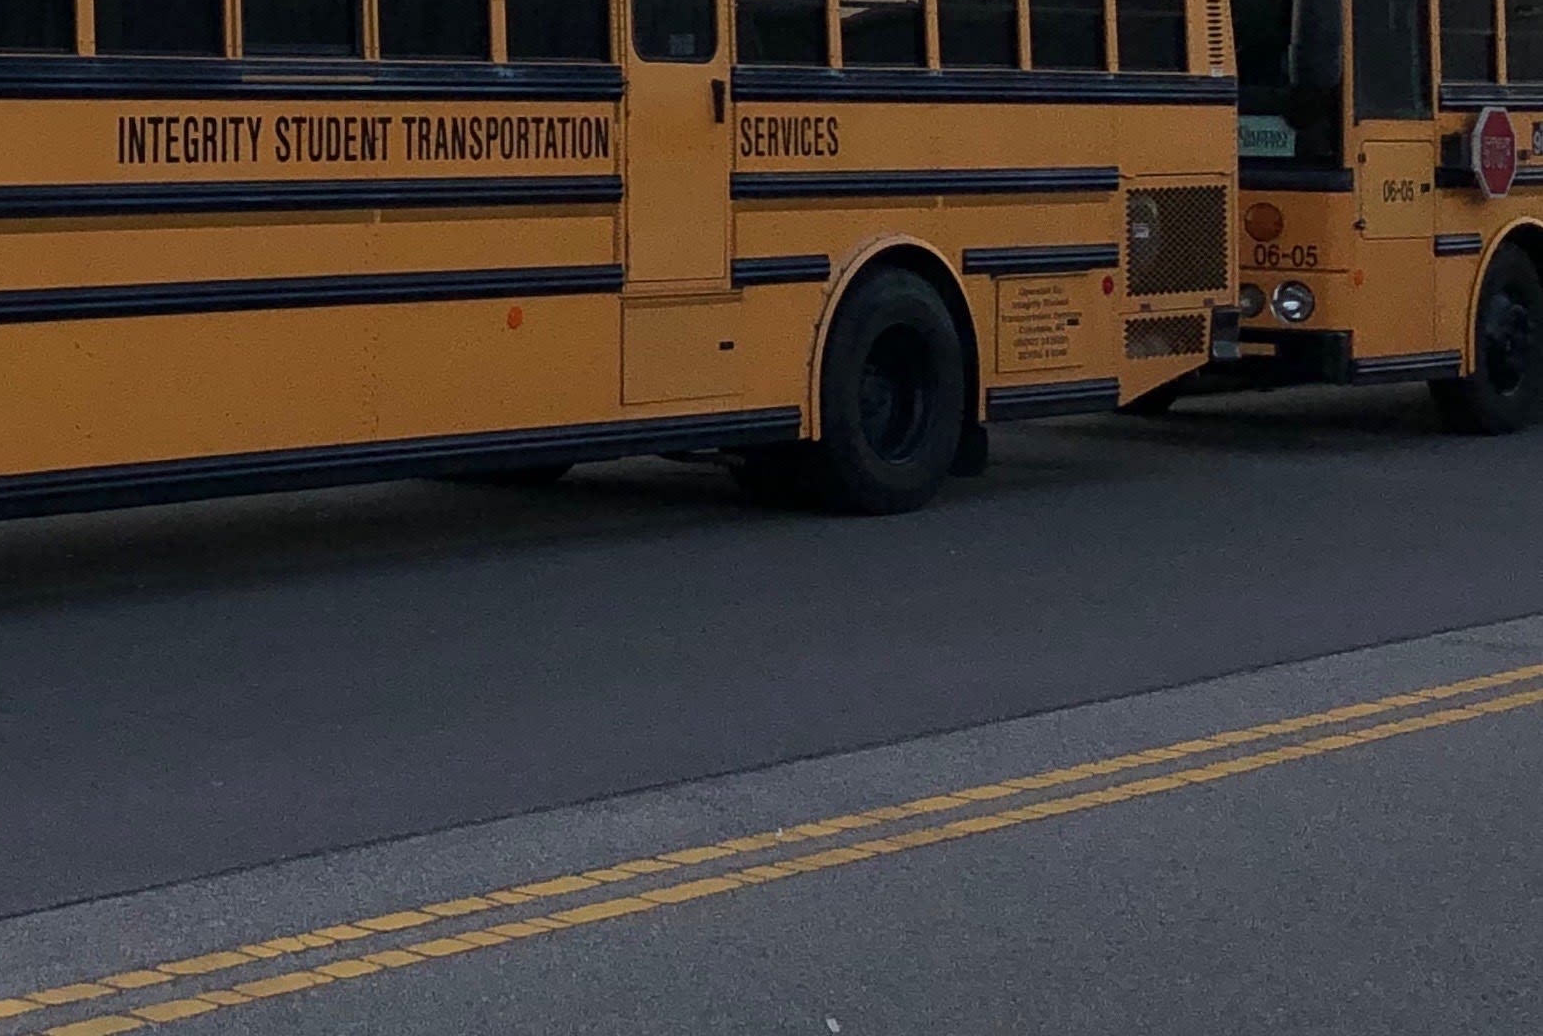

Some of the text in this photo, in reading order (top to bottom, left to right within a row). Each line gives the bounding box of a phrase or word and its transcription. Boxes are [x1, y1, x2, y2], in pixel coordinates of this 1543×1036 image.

[118, 116, 840, 165] INTEGRITY STUDENT TRANSPORTATION SERVICES
[1382, 179, 1415, 203] 06-05
[1254, 244, 1318, 267] 06-05
